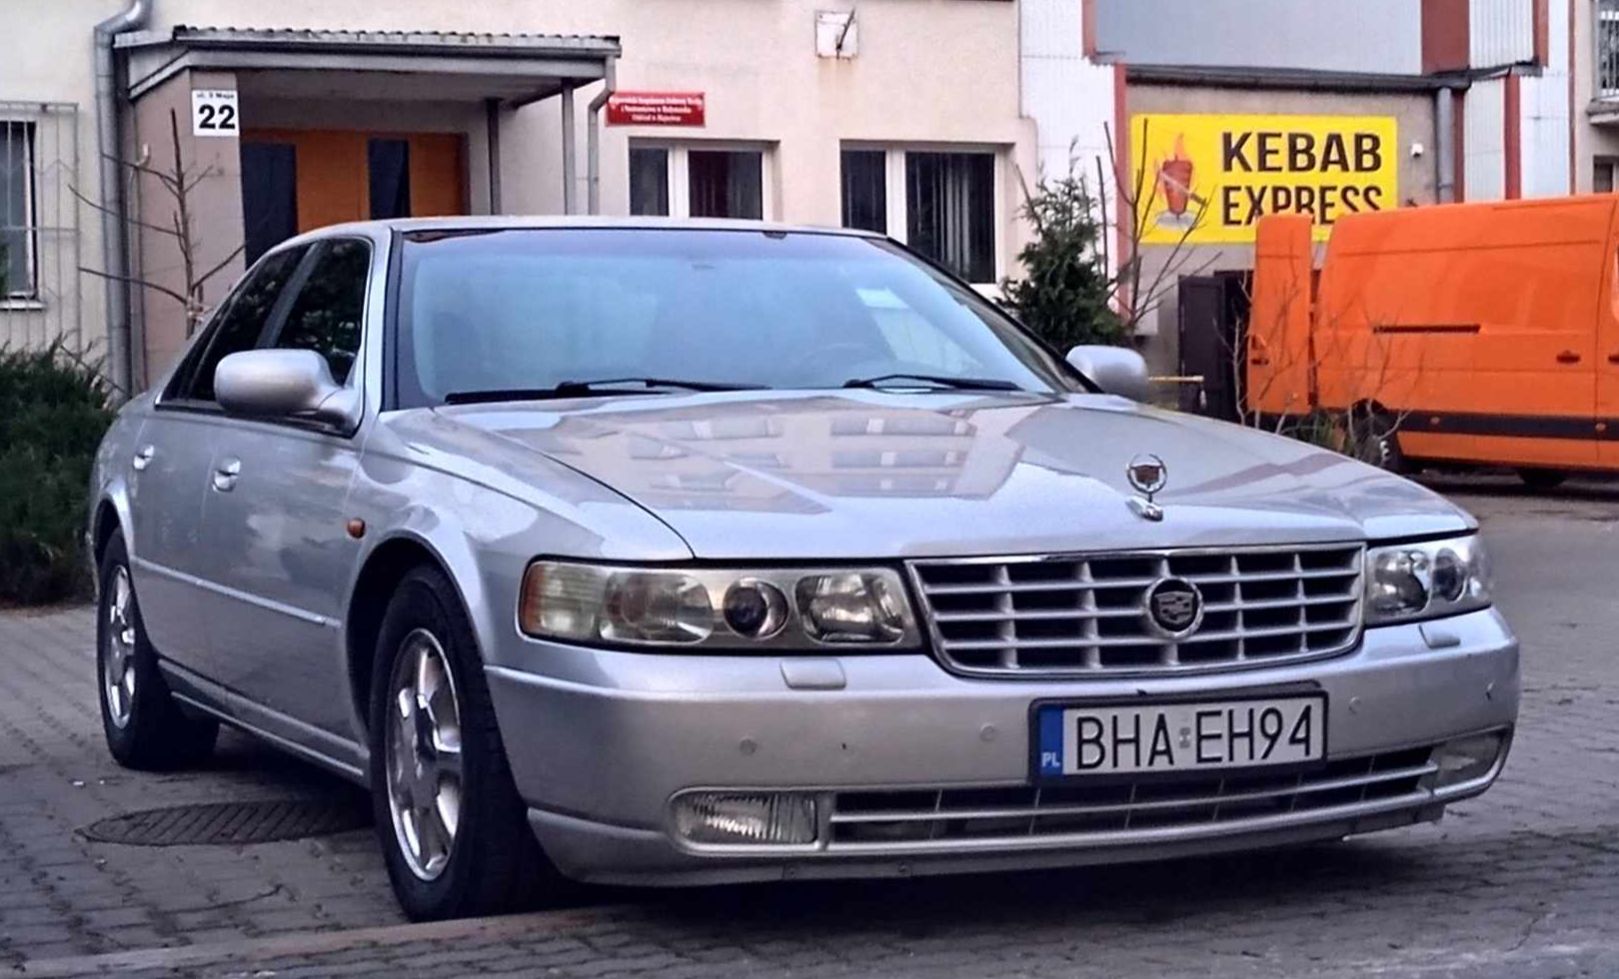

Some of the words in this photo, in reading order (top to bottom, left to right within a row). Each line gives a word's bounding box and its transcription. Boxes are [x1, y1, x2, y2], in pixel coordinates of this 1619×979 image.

[198, 104, 235, 129] 22
[1222, 132, 1382, 172] KEBAB
[1222, 185, 1383, 226] EXPRESS
[1076, 713, 1174, 770] BHA
[1195, 704, 1312, 763] EH94
[1041, 752, 1060, 767] PL
